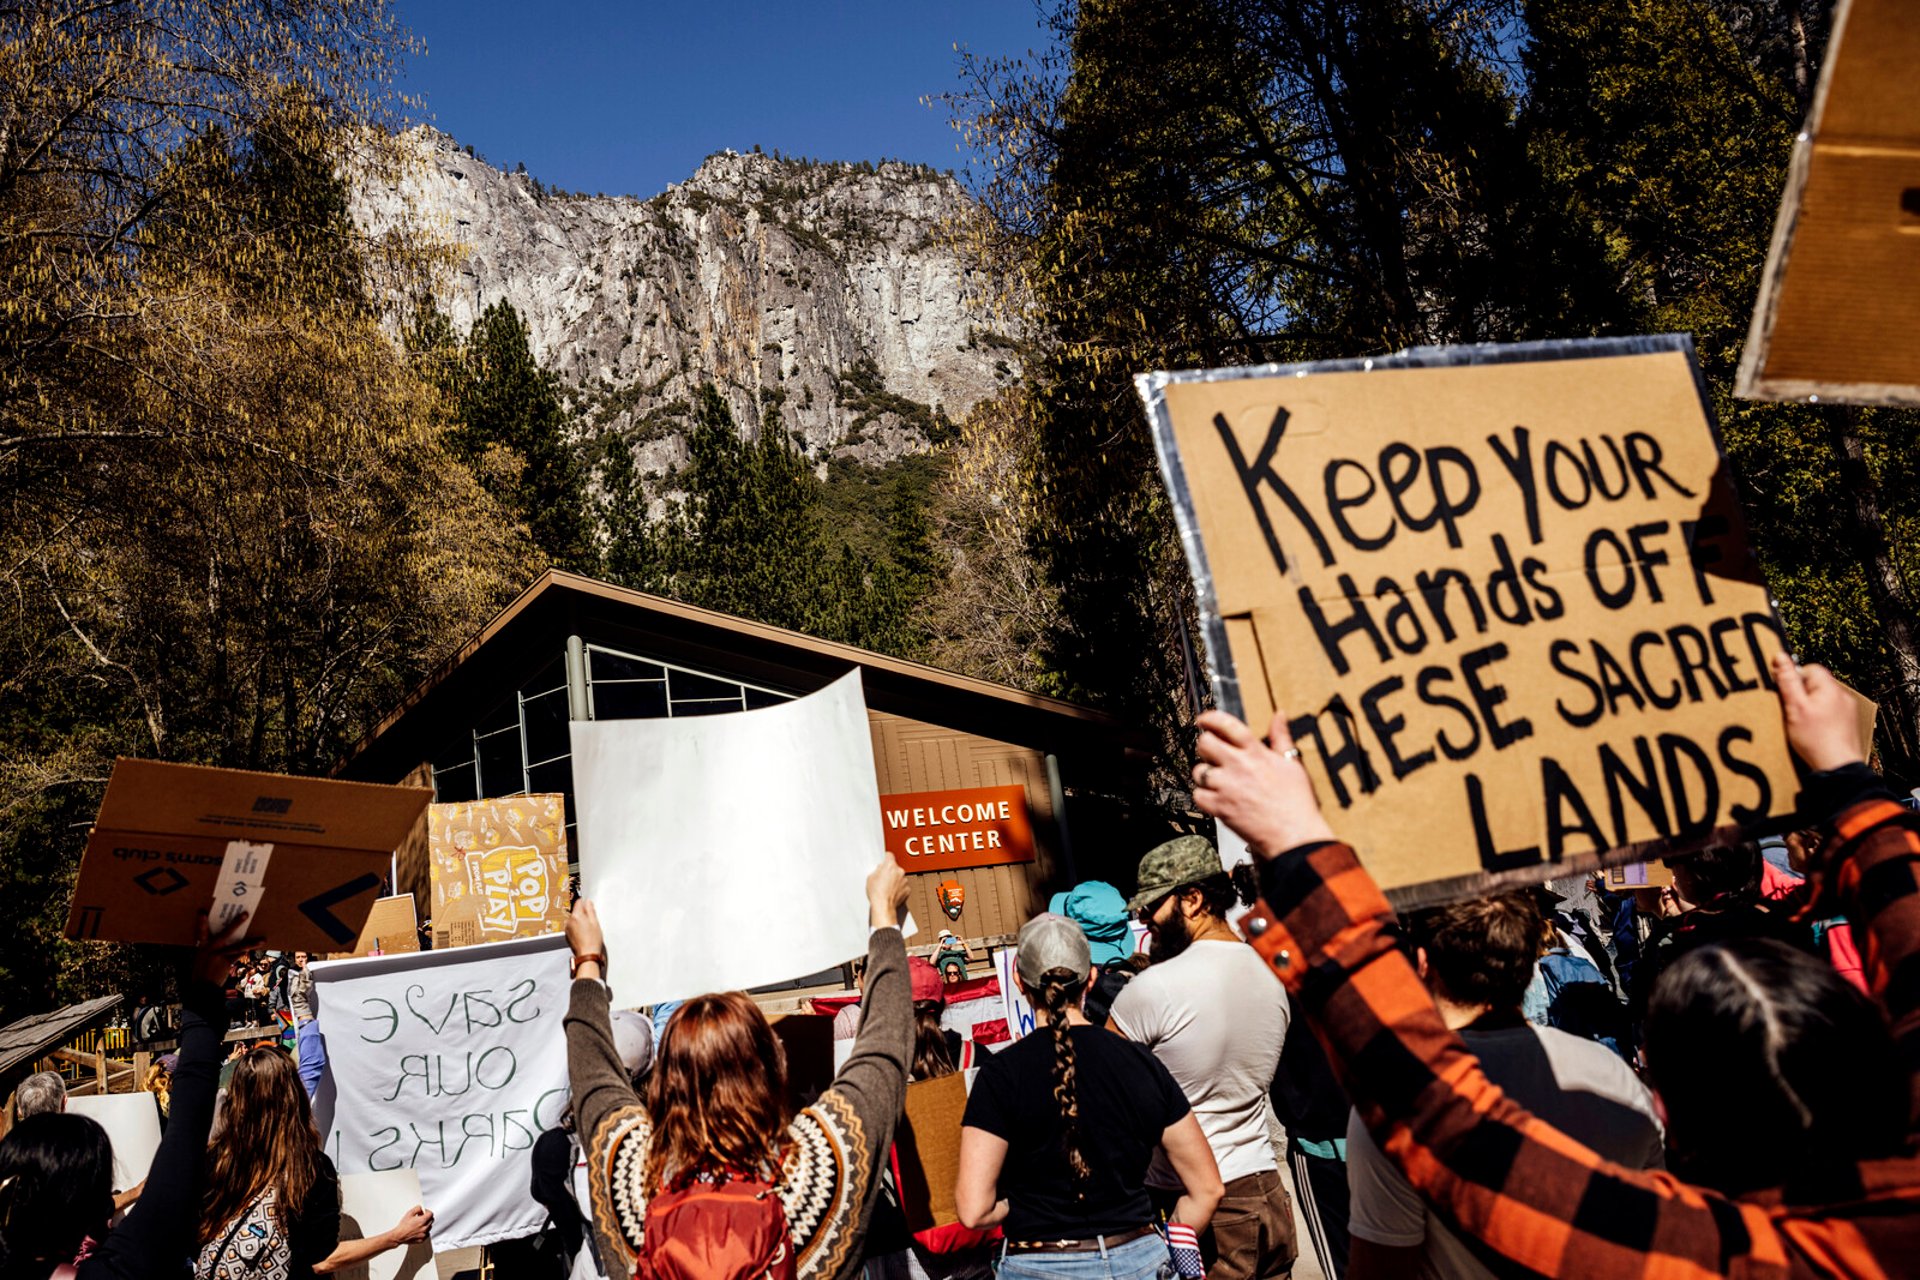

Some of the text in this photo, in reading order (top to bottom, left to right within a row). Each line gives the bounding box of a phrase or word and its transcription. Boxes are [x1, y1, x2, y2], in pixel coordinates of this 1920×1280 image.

[1212, 405, 1699, 576] Keep YOUR
[1297, 515, 1729, 676] Hands OFF
[1549, 611, 1784, 728] SACRED
[886, 800, 1011, 829] WELCOME
[1464, 724, 1772, 873] LANDS
[112, 847, 161, 862] club
[904, 829, 1003, 857] CENTER
[483, 869, 513, 927] PLAY
[516, 860, 546, 913] POP
